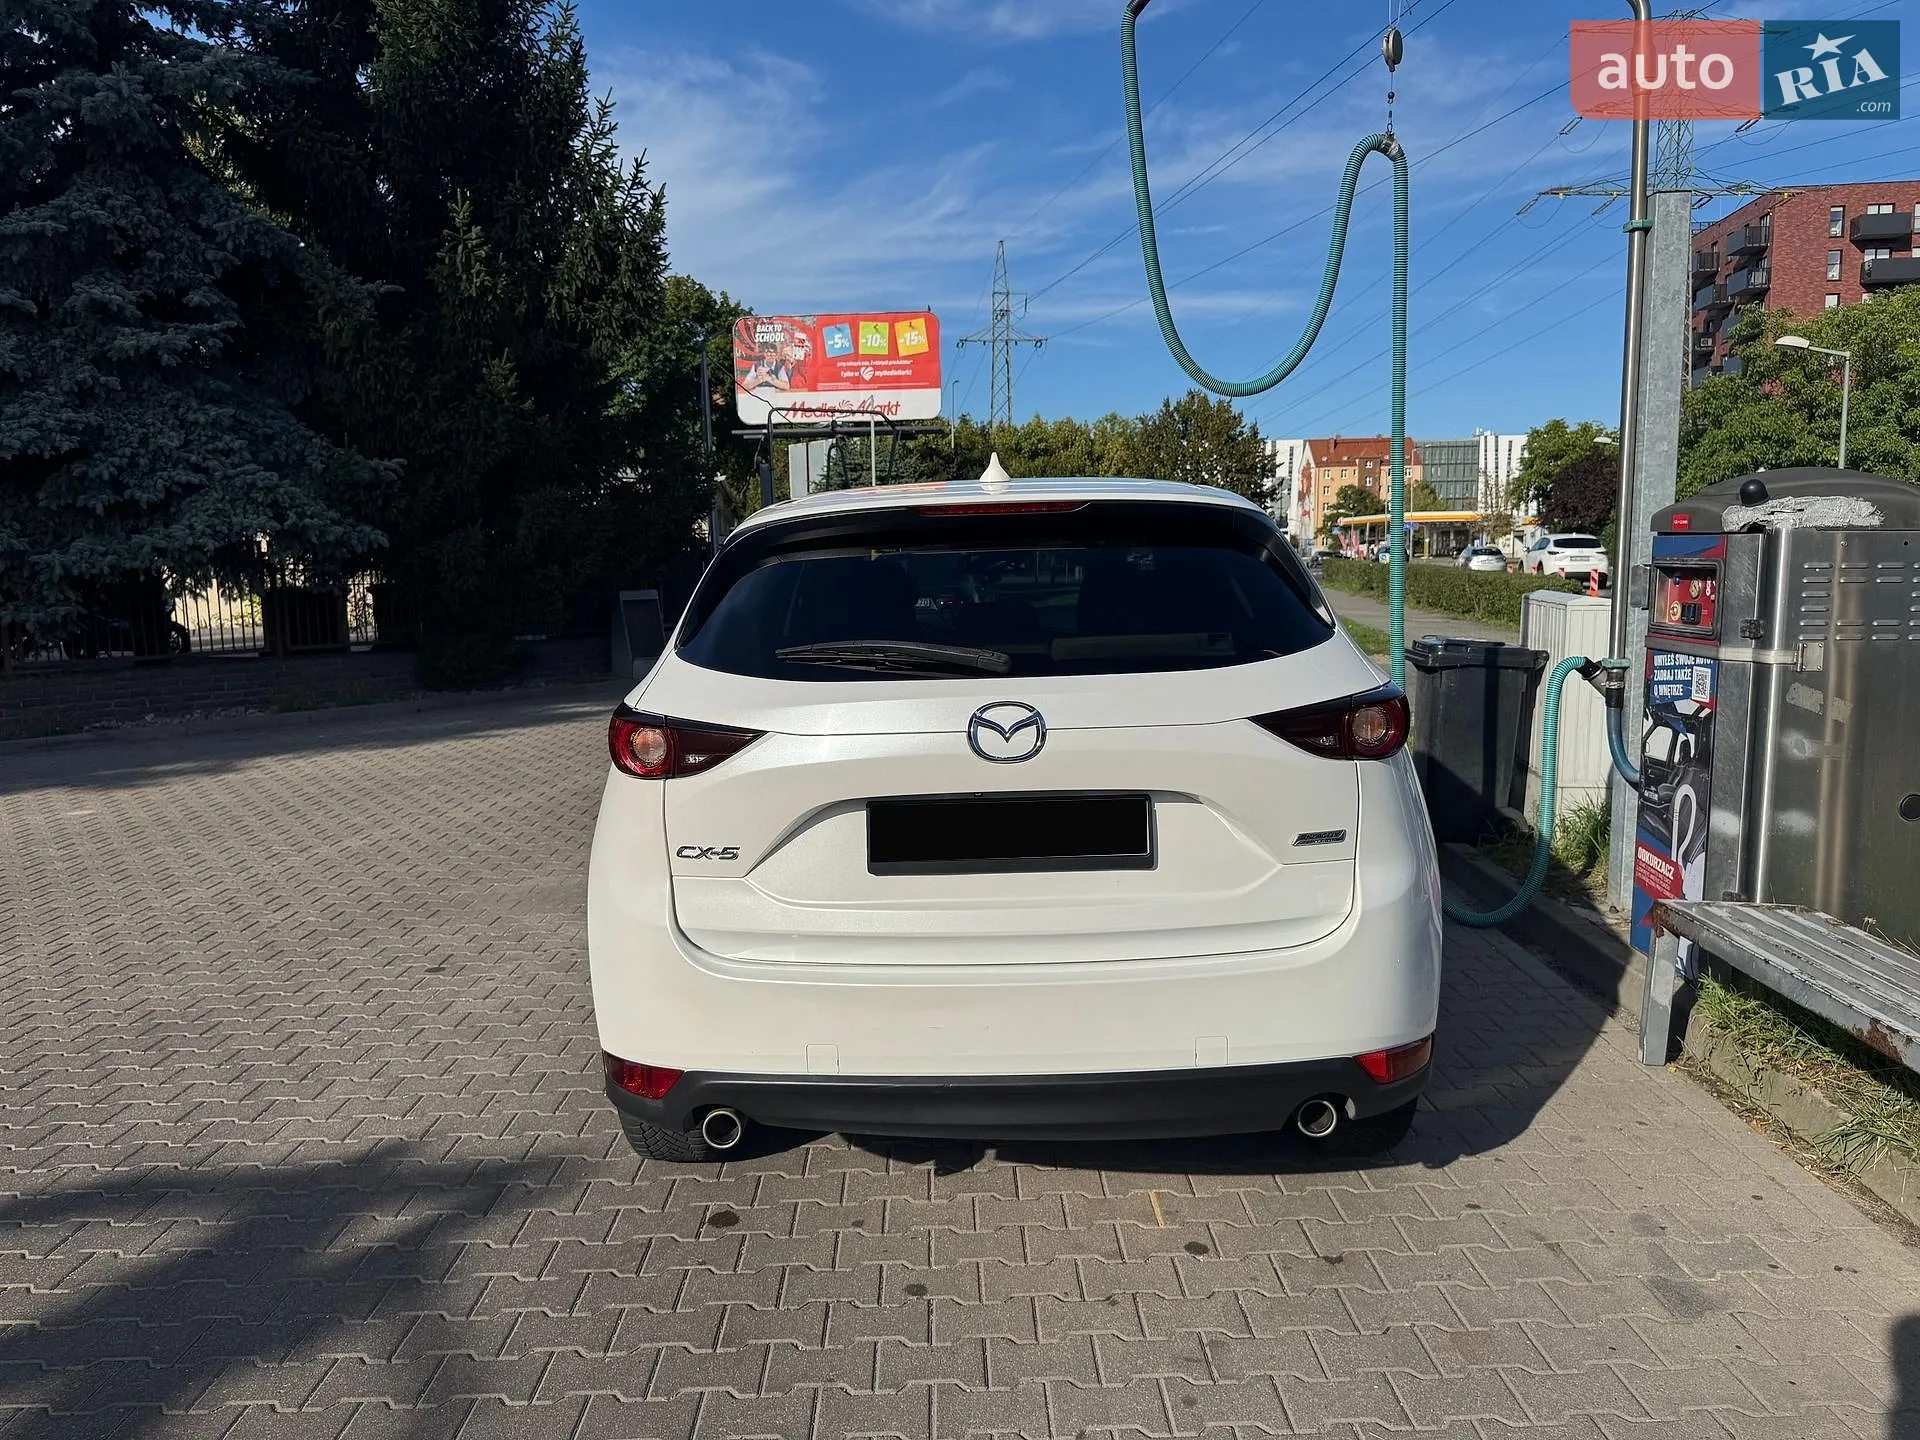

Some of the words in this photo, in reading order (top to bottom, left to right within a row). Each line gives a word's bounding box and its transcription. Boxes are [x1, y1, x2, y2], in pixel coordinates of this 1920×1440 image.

[756, 324, 774, 333] BACK
[774, 324, 782, 332] TO
[754, 332, 785, 343] SCHOOL
[827, 333, 850, 349] -5%
[860, 334, 887, 347] -10%
[899, 330, 926, 347] -15%
[1675, 653, 1695, 666] SWOJE
[1674, 667, 1692, 681] TAKŻE
[1653, 684, 1659, 697] O
[1659, 684, 1684, 699] WNĘTRZE
[676, 845, 741, 861] CX-5
[1637, 846, 1675, 881] ODKURZACZ
